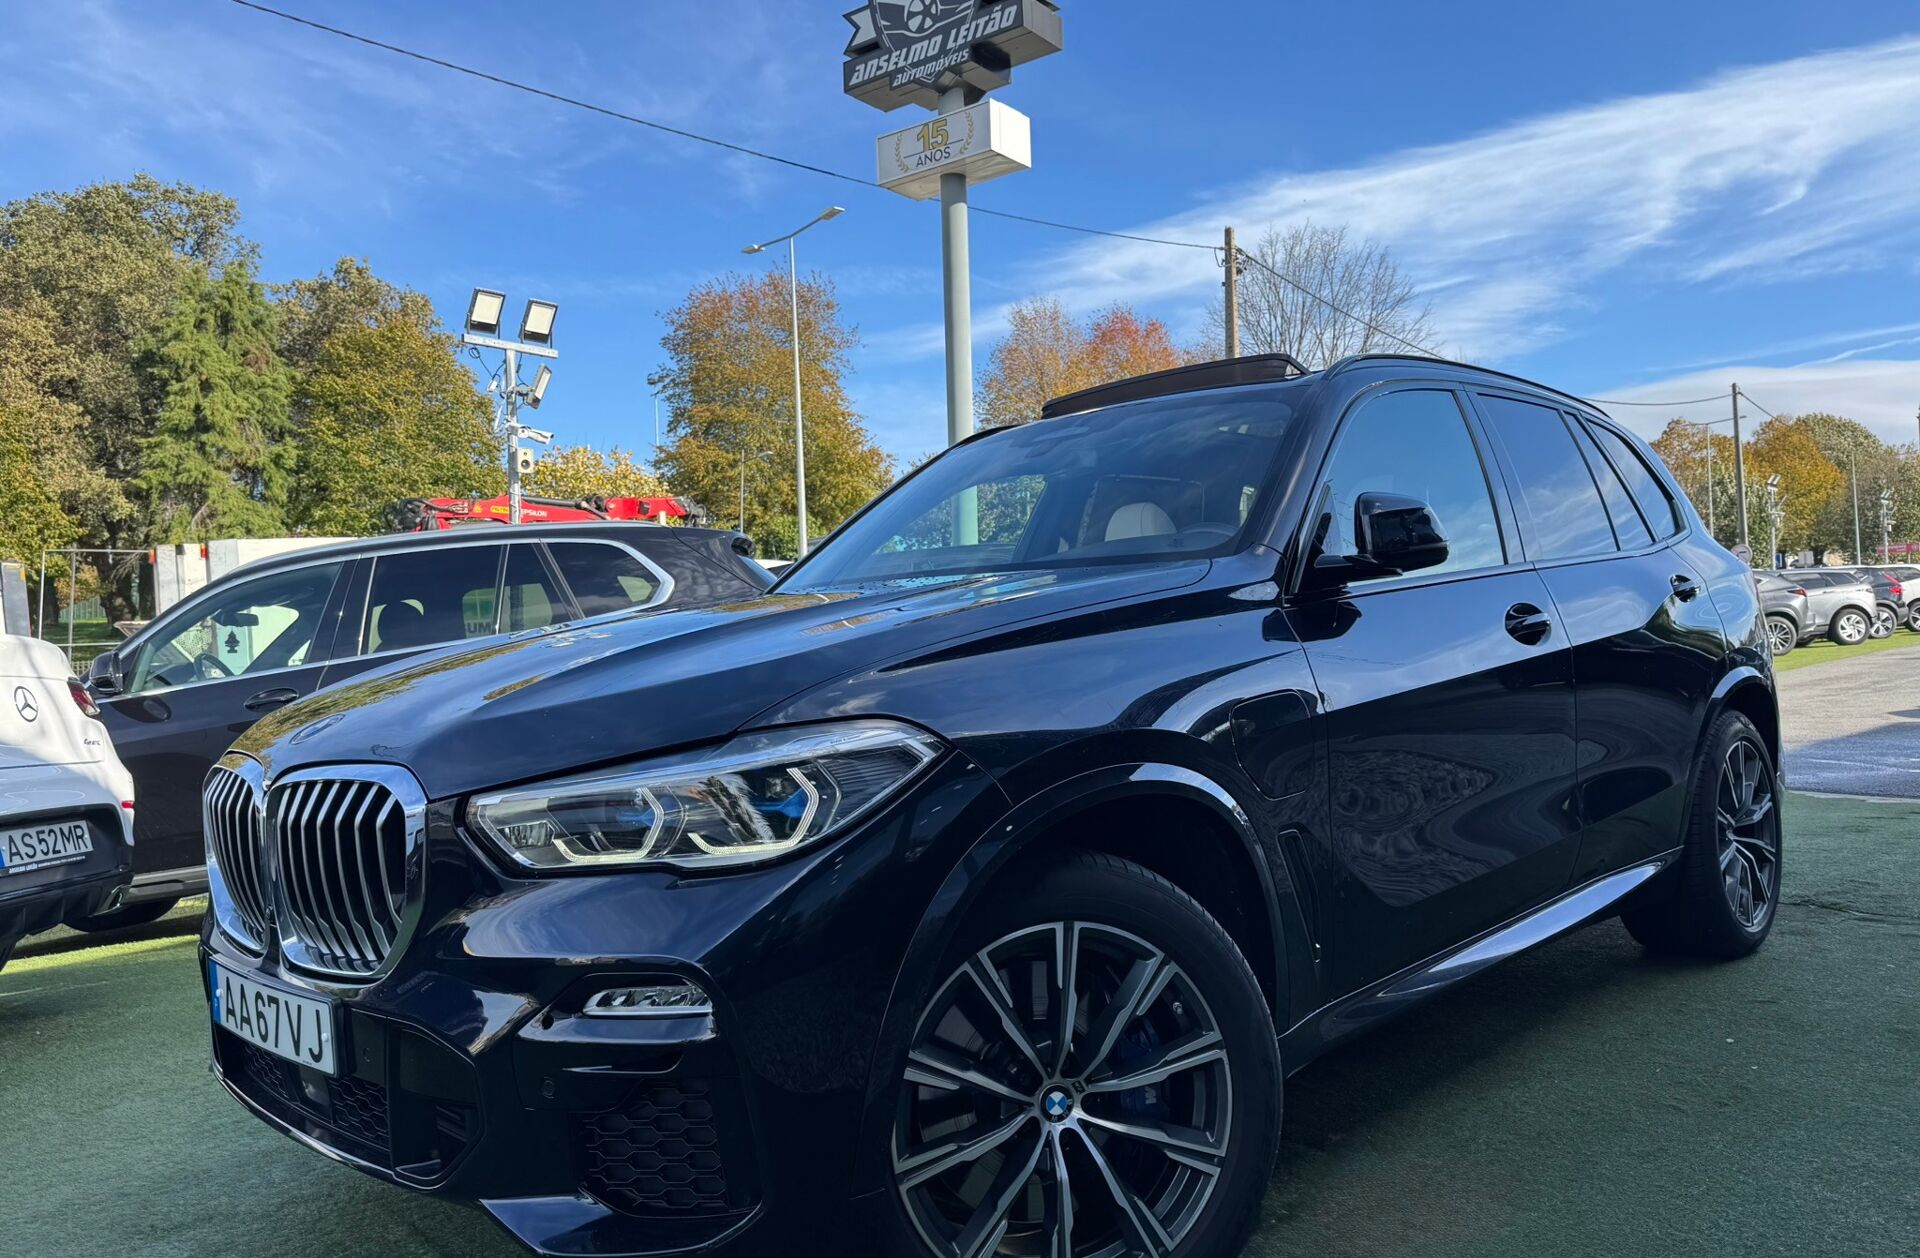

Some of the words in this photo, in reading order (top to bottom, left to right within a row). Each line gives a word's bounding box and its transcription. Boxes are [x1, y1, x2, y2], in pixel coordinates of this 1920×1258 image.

[850, 35, 943, 86] ANSELMO
[947, 5, 1018, 48] LEITÃO
[917, 118, 949, 152] 15
[916, 147, 951, 168] ANOS
[9, 824, 88, 863] AS52MR
[225, 976, 323, 1063] AA67VJ
